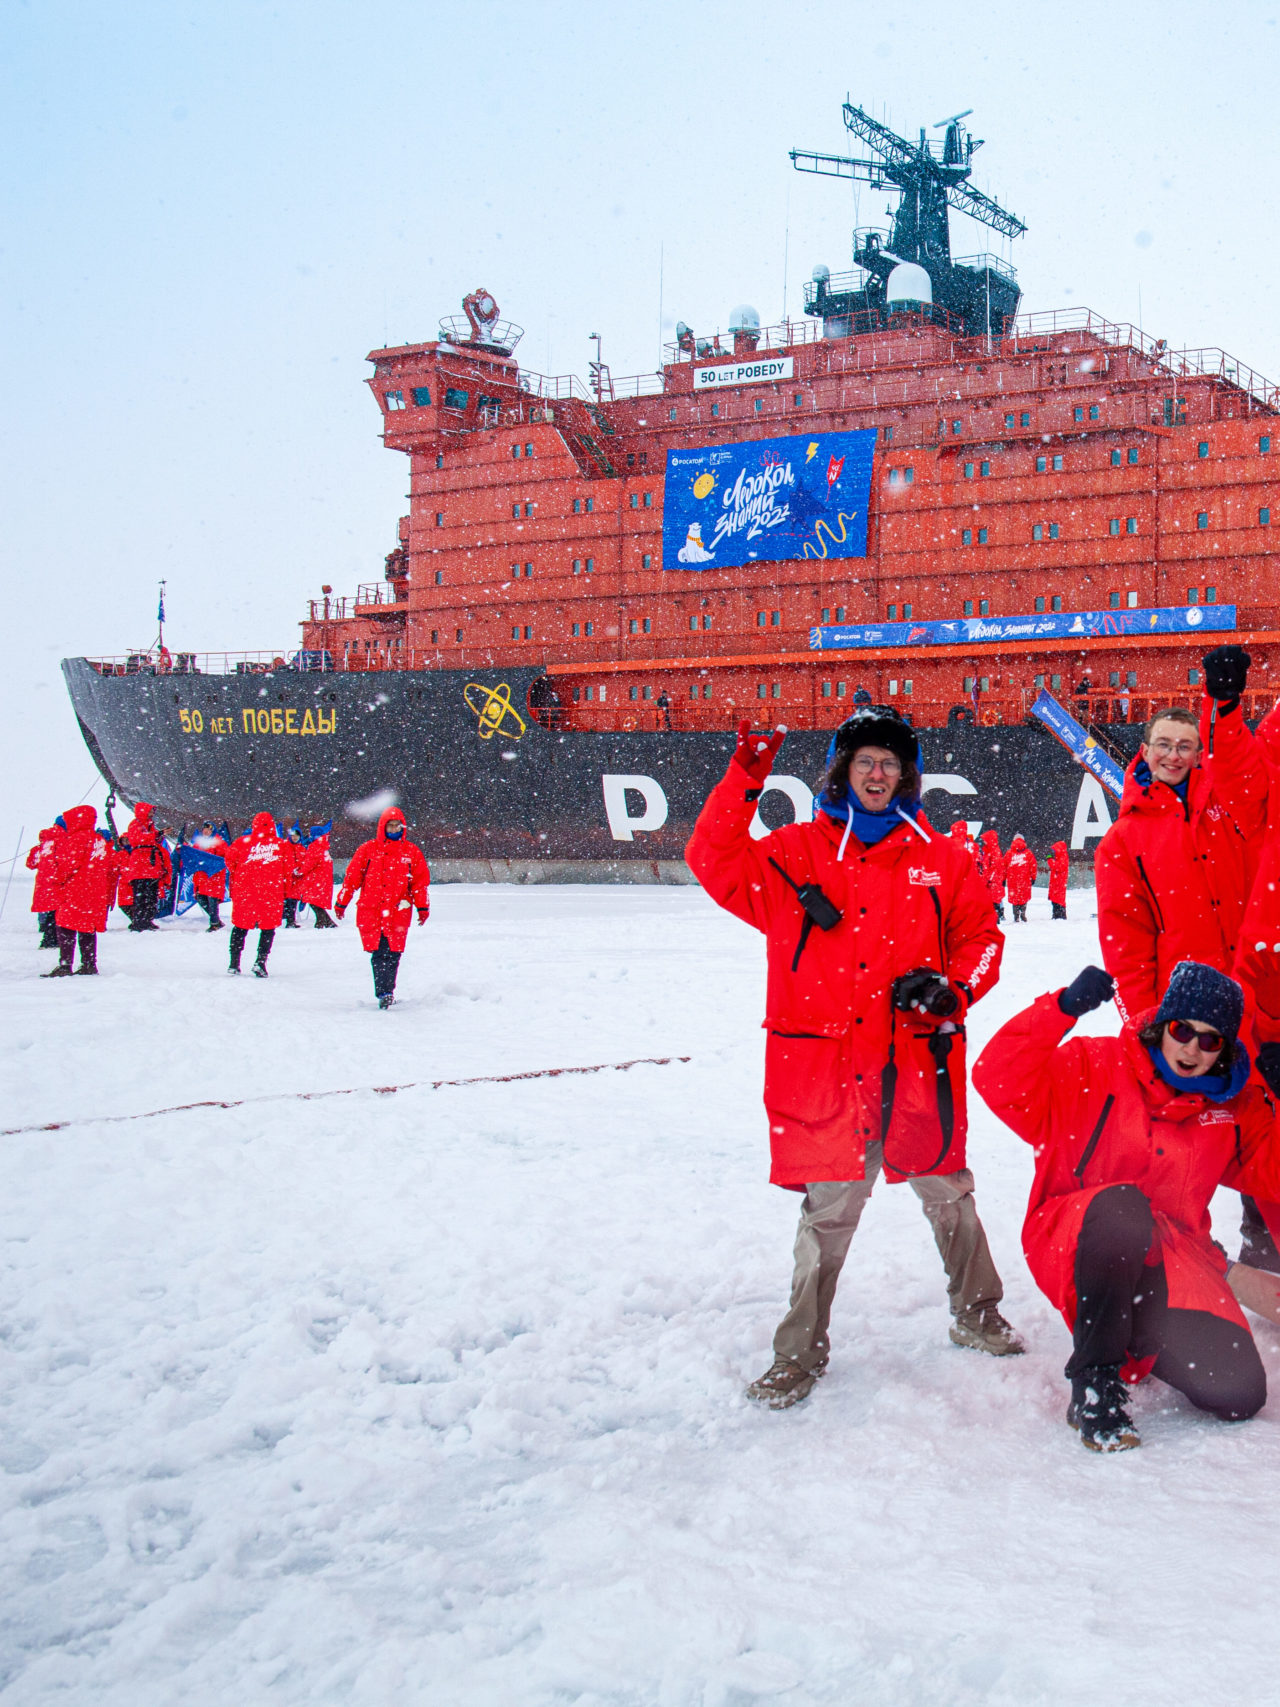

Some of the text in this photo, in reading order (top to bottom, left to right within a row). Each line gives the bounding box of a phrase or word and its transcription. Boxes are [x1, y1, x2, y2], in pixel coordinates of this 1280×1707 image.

[701, 363, 785, 383] 50 LET POBEDY
[746, 504, 790, 541] 2022
[179, 709, 203, 734] 50
[242, 708, 336, 737] ПОБЕДЫ
